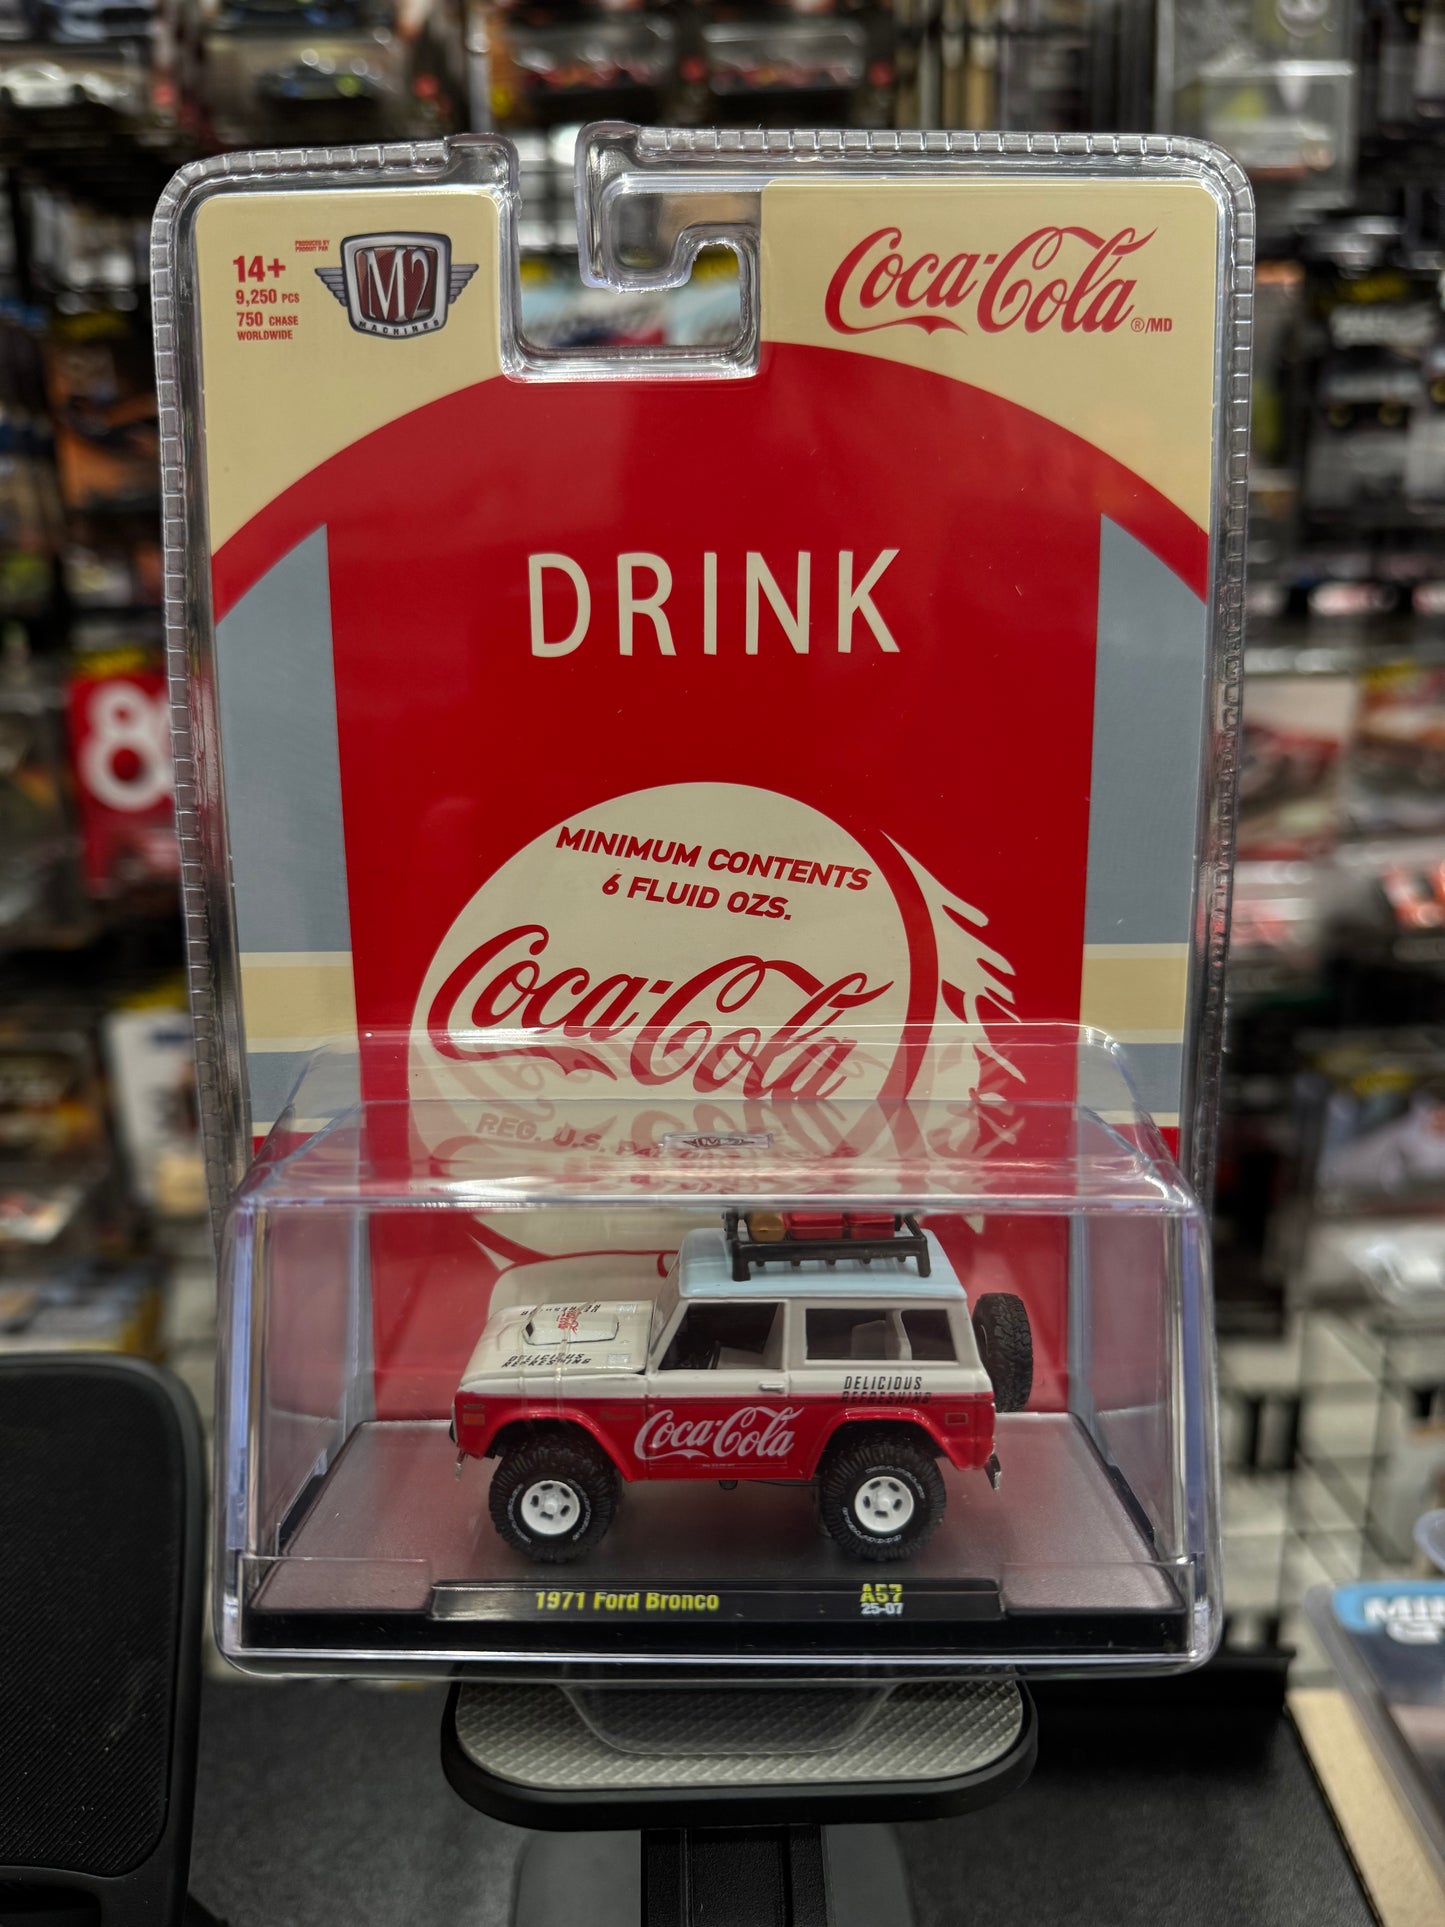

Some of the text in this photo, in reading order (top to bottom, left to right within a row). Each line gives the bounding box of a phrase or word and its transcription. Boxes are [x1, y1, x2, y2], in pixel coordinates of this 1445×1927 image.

[233, 255, 286, 283] 14+
[825, 226, 1158, 335] Coca-Cola
[363, 246, 431, 322] M2
[235, 288, 300, 307] 9,250 PCS
[236, 311, 299, 327] 750 CHASE
[359, 319, 440, 335] MACHINES
[237, 330, 293, 341] WORLDWIDE
[528, 548, 901, 658] DRINK
[555, 826, 872, 891] MINIMUM CONTENTS
[602, 873, 792, 921] 6 FLUID OZS.
[427, 924, 895, 1102] Coca-Cola
[843, 1376, 922, 1390] DELICIOUS
[633, 1406, 804, 1460] Coca-Cola
[535, 1591, 720, 1611] 1971 Ford Bronco
[860, 1583, 903, 1603] A57
[860, 1602, 904, 1615] 25-07
